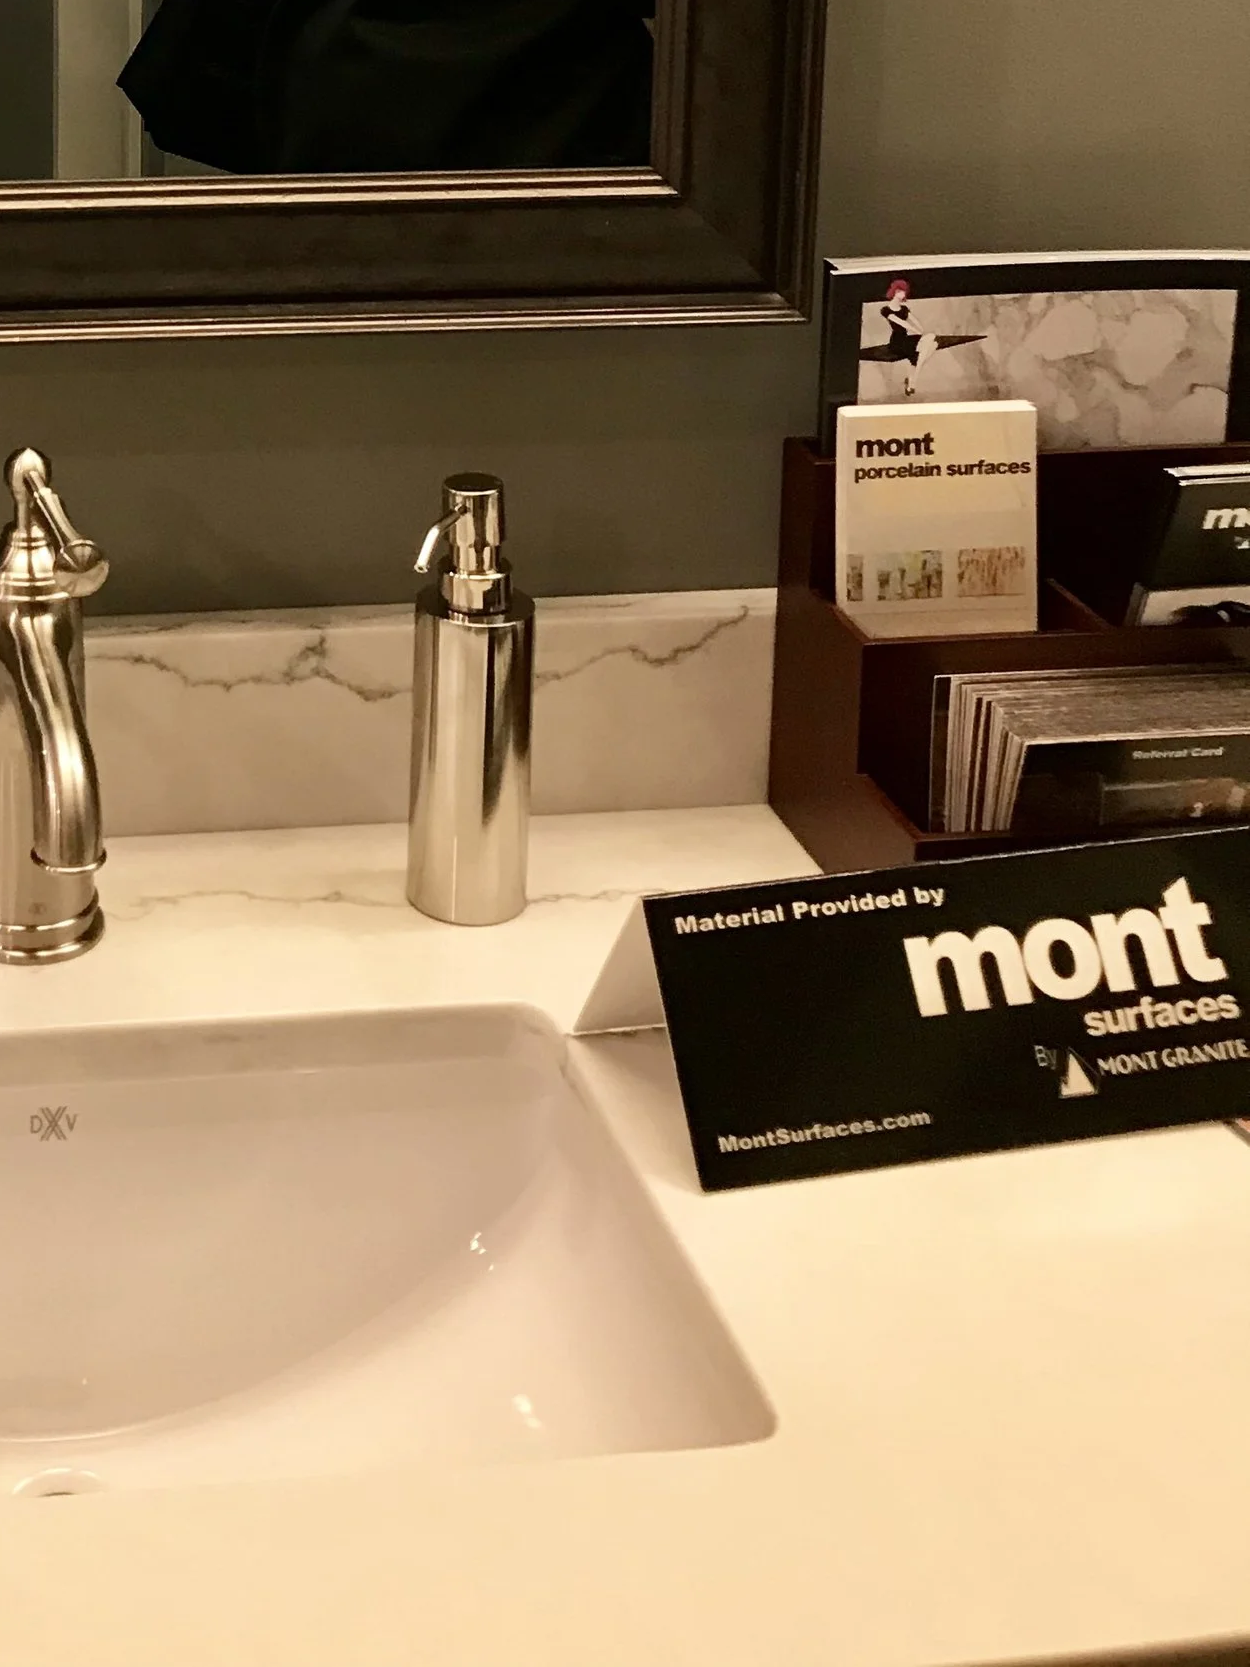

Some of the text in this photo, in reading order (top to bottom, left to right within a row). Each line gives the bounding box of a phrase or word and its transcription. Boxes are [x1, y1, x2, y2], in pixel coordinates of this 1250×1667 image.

[855, 431, 935, 458] mont
[854, 459, 1032, 483] porcelain surfaces
[1131, 746, 1224, 760] Referral Card
[674, 886, 945, 935] Material Provided by
[903, 875, 1229, 1018] mont
[1083, 993, 1242, 1036] surfaces
[1097, 1050, 1160, 1076] MONT
[1161, 1038, 1250, 1068] GRANITE
[717, 1111, 932, 1153] MontSurfaces.com
